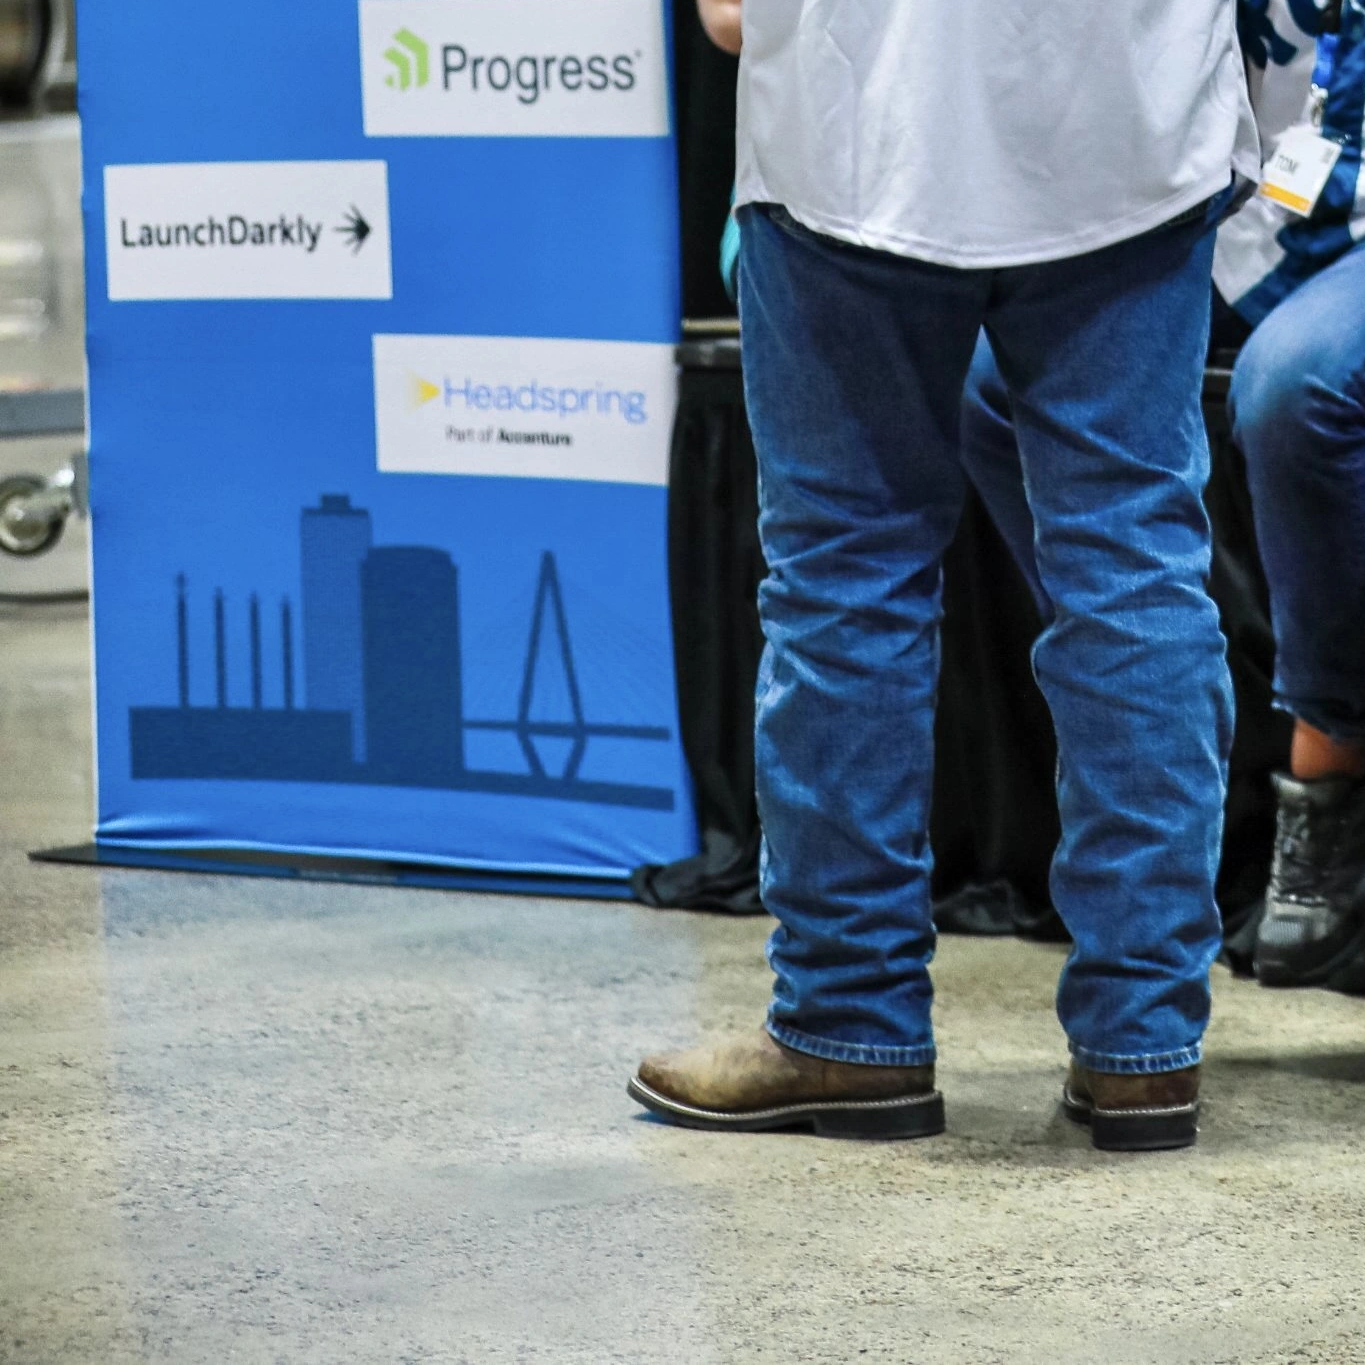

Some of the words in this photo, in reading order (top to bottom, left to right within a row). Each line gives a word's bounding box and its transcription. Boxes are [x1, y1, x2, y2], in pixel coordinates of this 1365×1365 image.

[442, 44, 636, 104] Progress
[120, 215, 322, 253] LaunchDarkly
[444, 377, 648, 424] Headspring
[445, 426, 472, 443] Part
[476, 427, 494, 443] of
